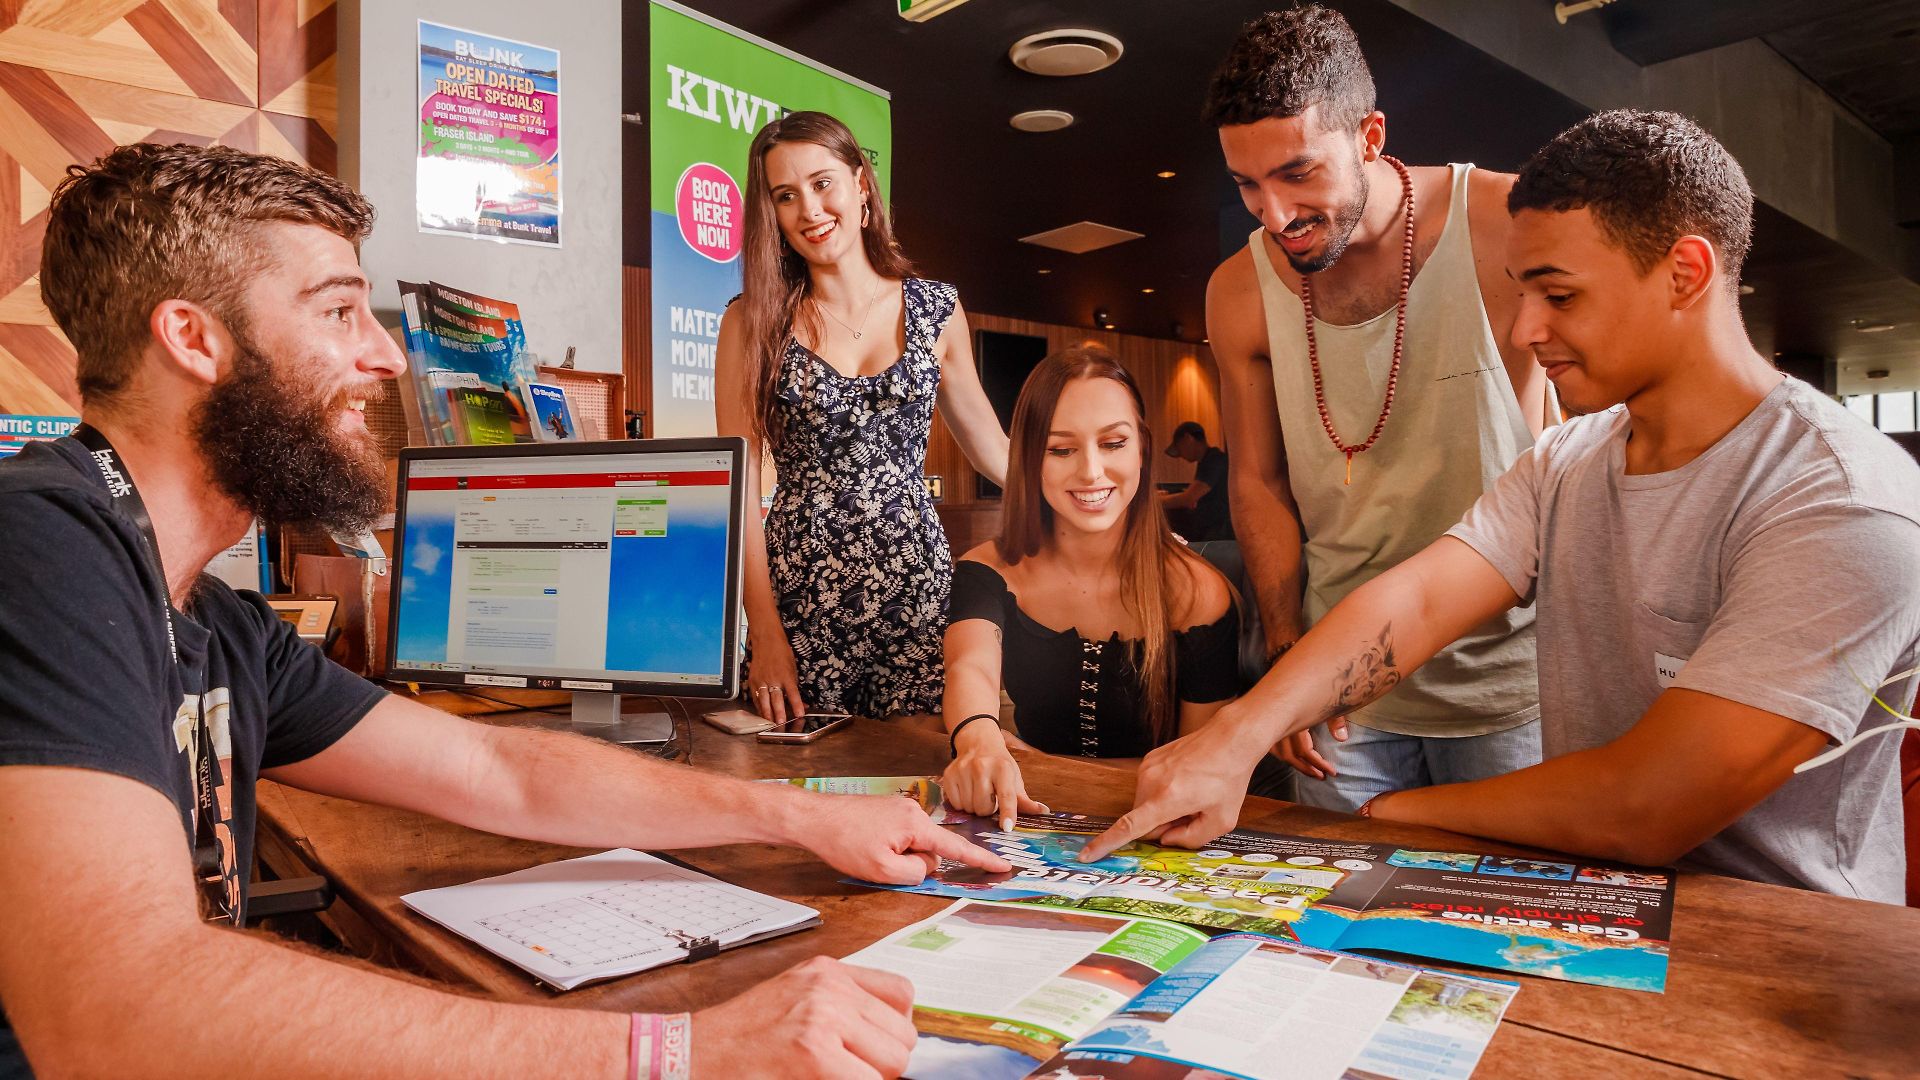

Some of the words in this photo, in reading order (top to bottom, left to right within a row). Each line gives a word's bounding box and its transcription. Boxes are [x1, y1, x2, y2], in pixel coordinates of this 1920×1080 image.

[468, 58, 487, 66] SLEEP
[489, 62, 508, 70] DRINK
[446, 62, 486, 85] OPEN
[488, 70, 535, 95] DATED
[436, 80, 482, 101] TRAVEL
[485, 88, 544, 114] SPECIALS!
[432, 110, 448, 119] OPEN
[450, 114, 467, 122] DATED
[468, 116, 490, 126] TRAVEL
[504, 122, 526, 132] MONTHS
[436, 101, 456, 112] BOOK
[458, 105, 480, 116] TODAY
[483, 110, 498, 119] AND
[499, 112, 518, 122] SAVE
[518, 114, 541, 126] $174
[433, 127, 464, 139] FRASER
[466, 130, 494, 144] ISLAND
[692, 176, 730, 205] BOOK
[692, 200, 732, 228] HERE
[512, 221, 528, 232] Bunk
[530, 222, 552, 234] Travel
[696, 225, 730, 250] NOW!
[438, 287, 473, 309] MORETON
[474, 302, 500, 318] ISLAND
[434, 305, 466, 328] MORETON
[468, 321, 496, 336] ISLAND
[440, 336, 480, 353] RAINFOREST
[484, 340, 506, 353] TOURS
[0, 419, 32, 434] NTIC
[1441, 910, 1552, 929] active
[1499, 905, 1594, 924] simply
[1608, 917, 1645, 926] or
[1562, 922, 1640, 940] Get
